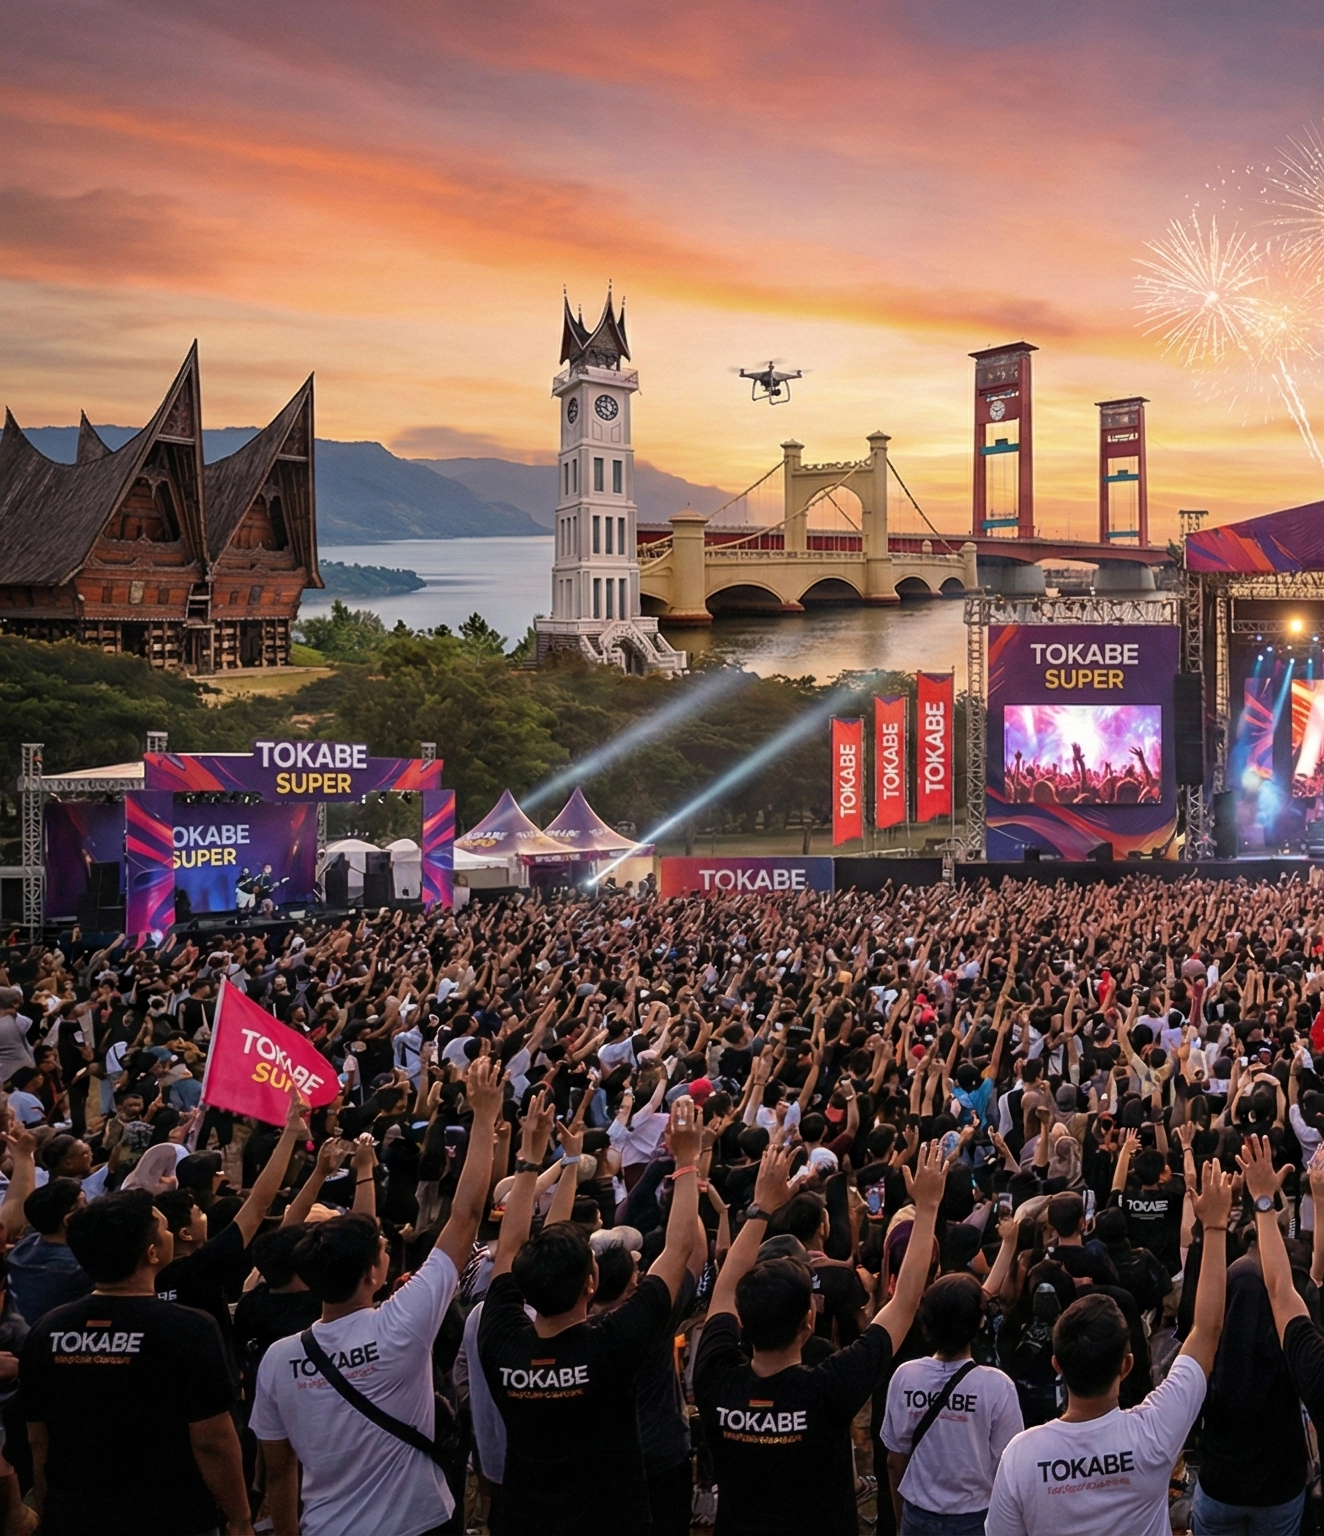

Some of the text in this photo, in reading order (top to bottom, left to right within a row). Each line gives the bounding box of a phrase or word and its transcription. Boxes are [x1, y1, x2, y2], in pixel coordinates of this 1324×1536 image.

[1030, 643, 1139, 665] TOKABE
[1044, 668, 1124, 690] SUPER
[255, 741, 367, 769] TOKABE
[924, 701, 945, 794] TOKABE
[882, 722, 900, 800] TOKABE
[276, 772, 351, 794] SUPER
[839, 743, 857, 818] TOKABE
[172, 824, 250, 848] OKABE
[172, 847, 236, 870] SUPER
[698, 868, 806, 891] TOKABE
[49, 1331, 145, 1353] TOKABE
[499, 1365, 590, 1389] TOKABE
[716, 1406, 808, 1433] TOKABE
[1037, 1450, 1135, 1483] TOKABE
